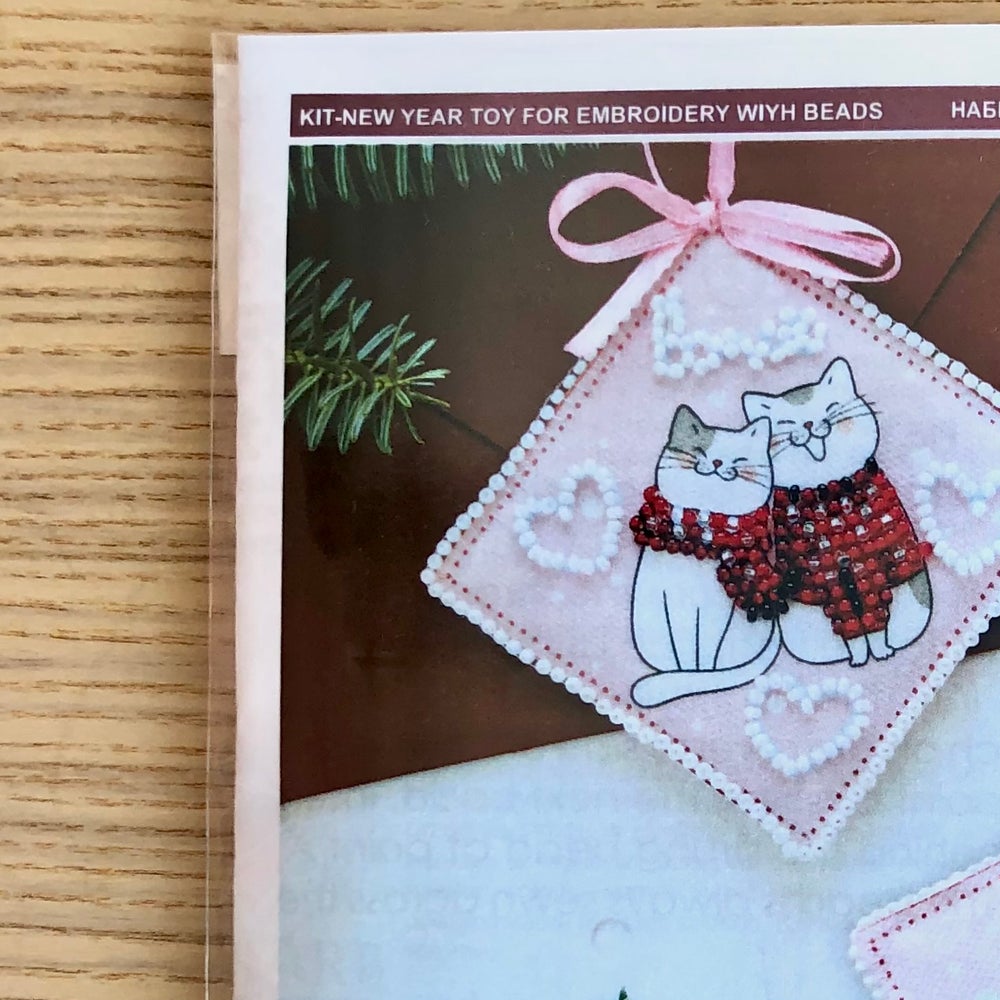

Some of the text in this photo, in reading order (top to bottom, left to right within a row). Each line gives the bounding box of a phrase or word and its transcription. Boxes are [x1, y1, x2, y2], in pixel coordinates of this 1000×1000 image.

[300, 101, 883, 126] KIT-NEW YEAR TOY FOR EMBROIDERY WIYH BEADS
